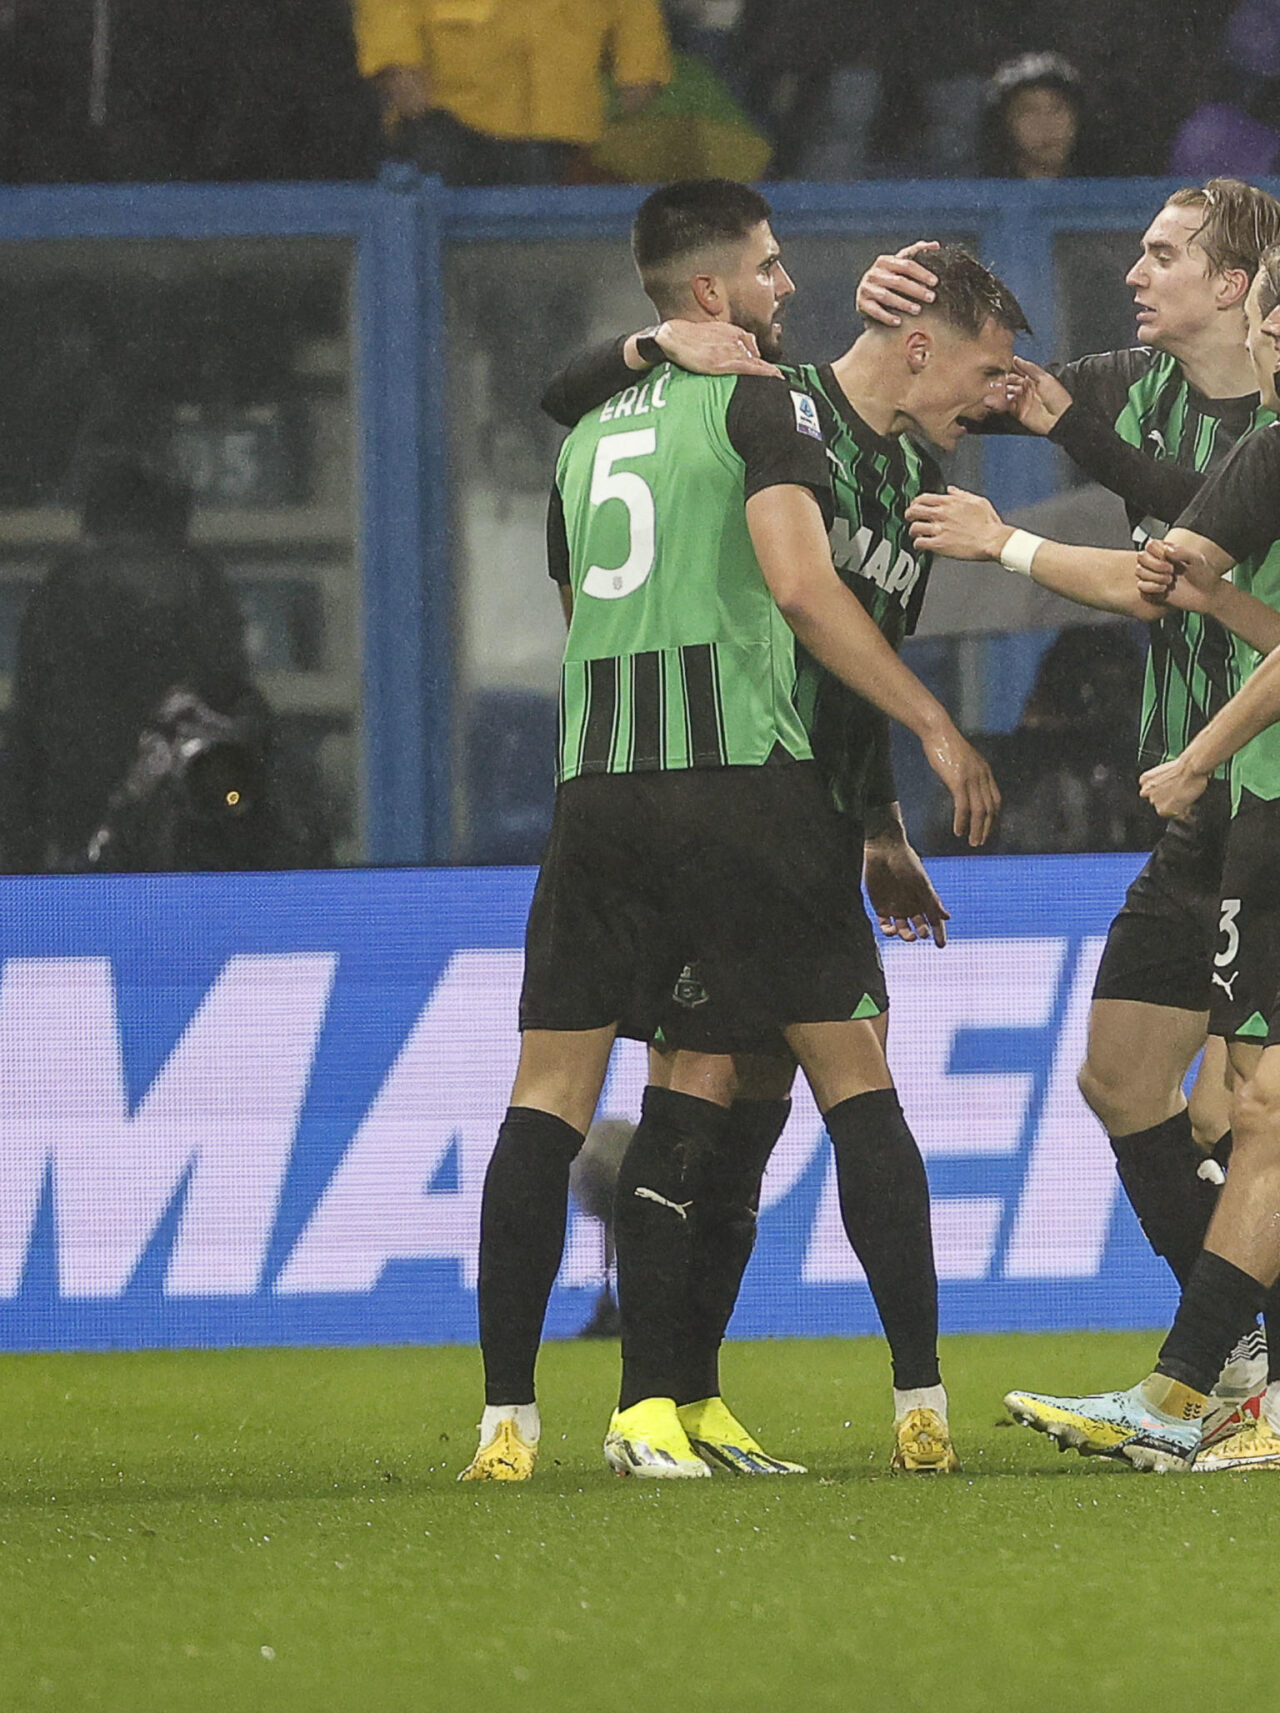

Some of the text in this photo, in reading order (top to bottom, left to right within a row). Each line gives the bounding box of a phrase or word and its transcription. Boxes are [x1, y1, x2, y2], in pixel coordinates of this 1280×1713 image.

[582, 427, 656, 600] 5
[1213, 898, 1241, 968] 3
[0, 937, 1120, 1298] MAEI
